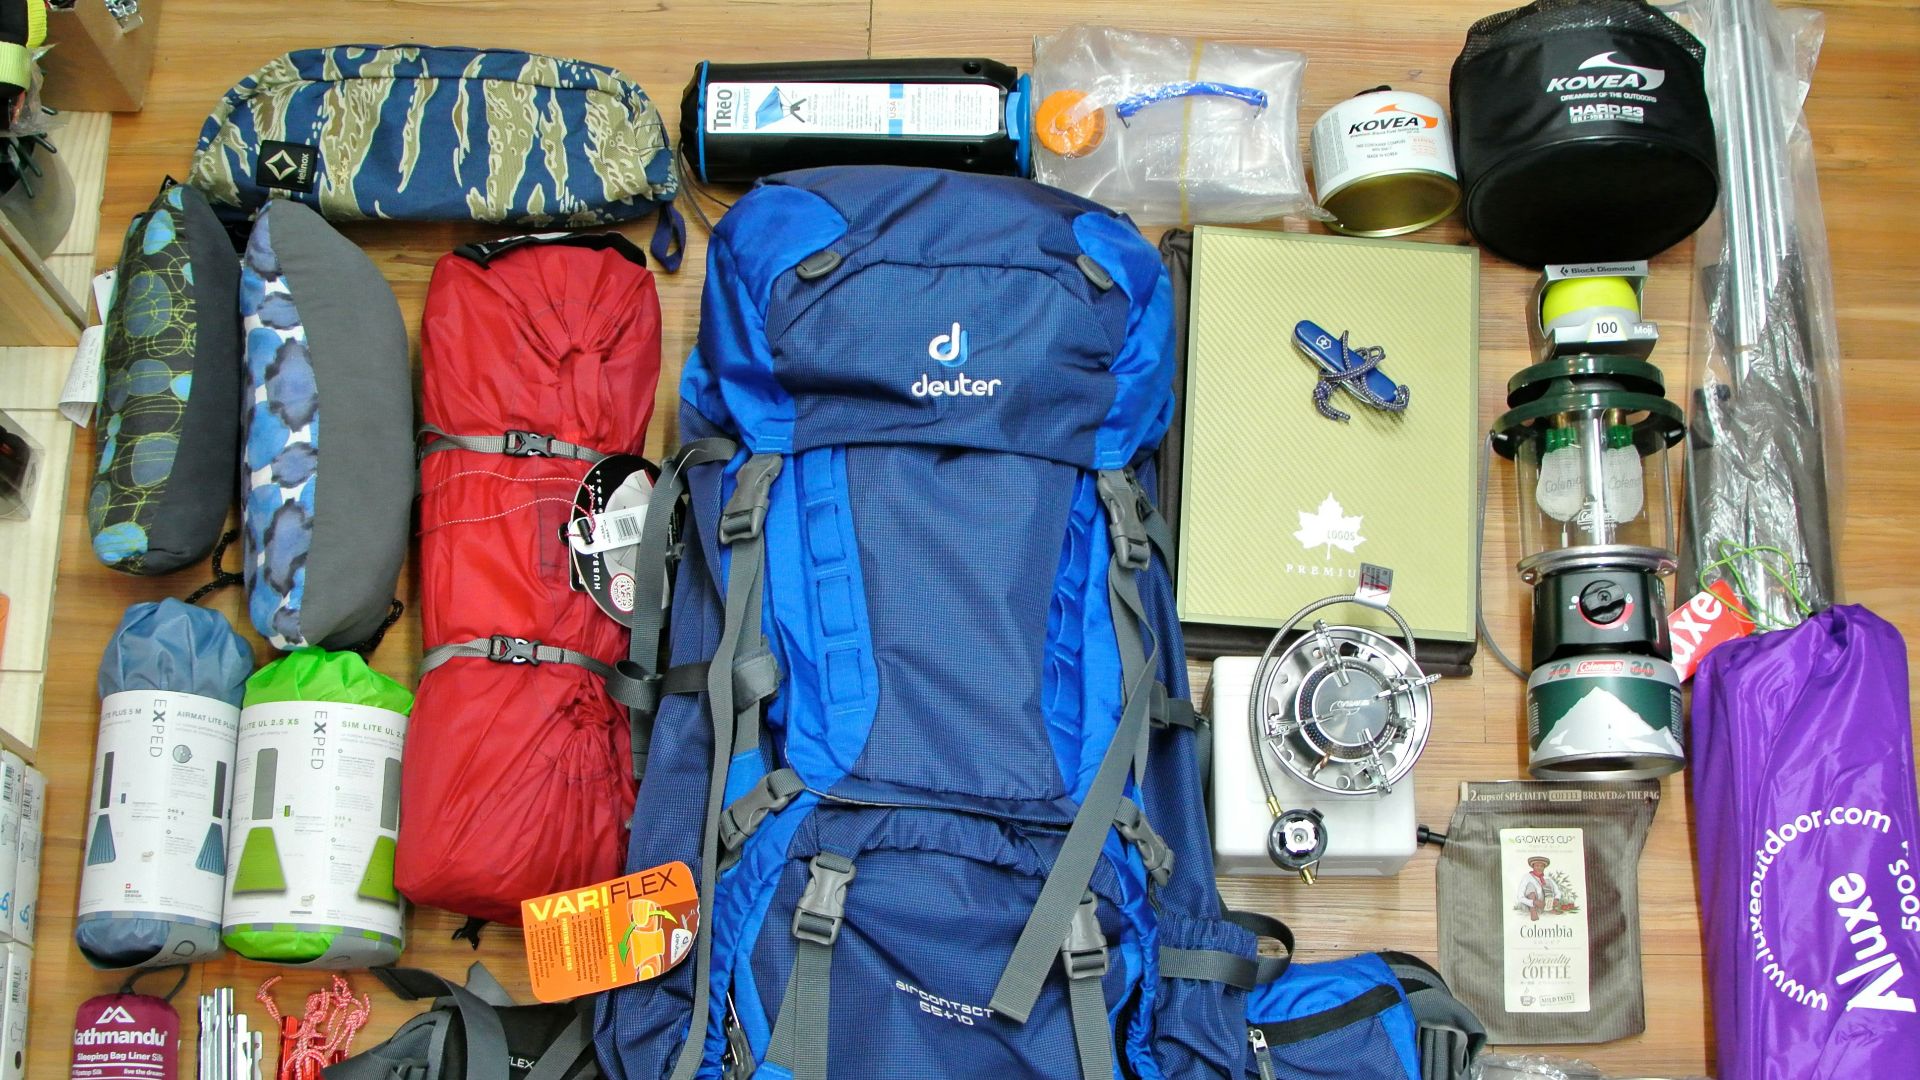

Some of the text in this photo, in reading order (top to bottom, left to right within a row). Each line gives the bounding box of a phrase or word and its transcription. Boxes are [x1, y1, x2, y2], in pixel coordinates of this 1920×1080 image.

[1546, 73, 1639, 93] KOVEA
[889, 100, 897, 119] USA
[1349, 116, 1419, 135] KOVEA
[297, 153, 309, 185] Helinox
[1571, 264, 1636, 274] Black Diamond
[1596, 321, 1618, 335] 100
[1633, 325, 1653, 337] Moji
[911, 372, 1002, 398] deuter
[1327, 530, 1356, 541] LOGOS
[1286, 563, 1357, 577] PREMIU
[1579, 661, 1615, 672] Coleman
[177, 711, 206, 722] AIRMAT
[208, 715, 222, 726] LITE
[149, 698, 168, 758] EXPED
[363, 723, 383, 733] LITE
[310, 710, 329, 770] EXPED
[1504, 791, 1549, 801] SPECIALTY
[1582, 790, 1617, 800] BREWED
[528, 866, 677, 922] VARIFLEX
[1750, 806, 1892, 1012] www.luxeoutdoor.com
[1520, 924, 1574, 939] Colombia
[1521, 965, 1572, 980] COFFEE
[895, 980, 995, 1019] aircontact
[77, 1052, 109, 1062] Sleeping
[109, 1051, 127, 1061] Bag
[128, 1051, 151, 1061] Liner
[508, 1056, 535, 1069] LEX
